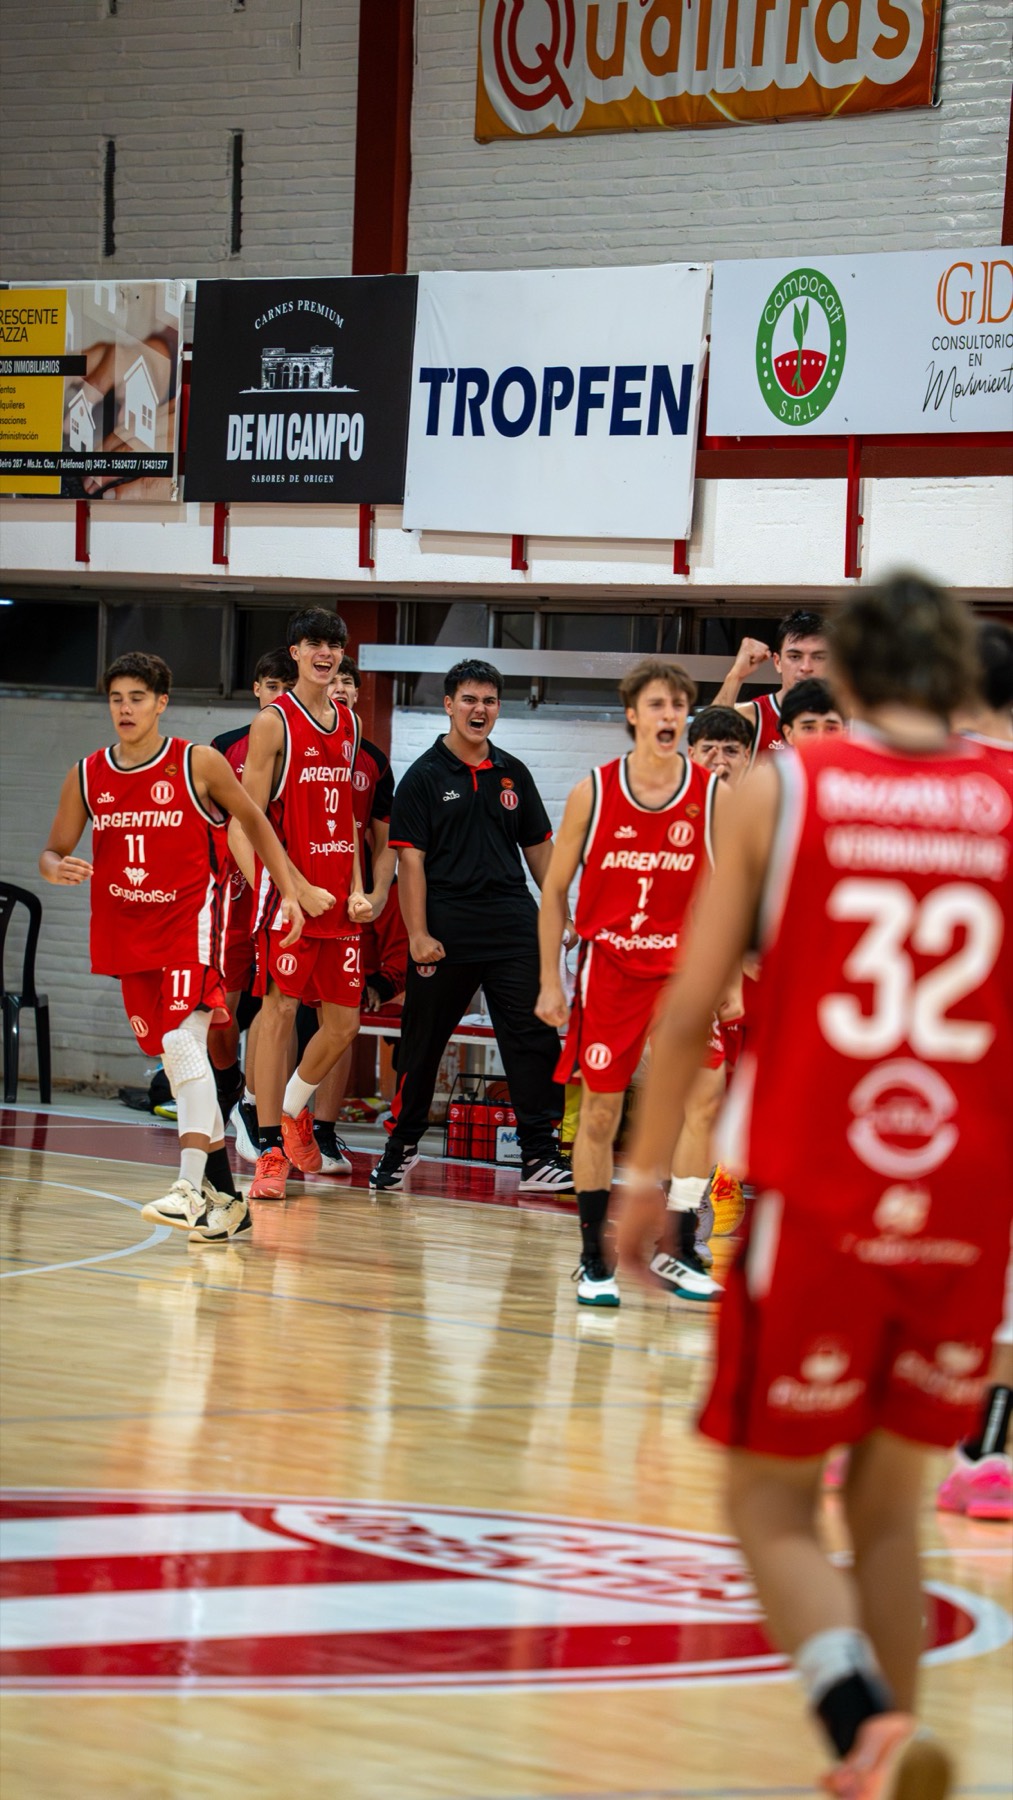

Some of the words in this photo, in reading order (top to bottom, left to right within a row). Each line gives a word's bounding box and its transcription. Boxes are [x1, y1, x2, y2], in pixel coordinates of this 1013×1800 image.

[254, 300, 294, 330] CARNES
[297, 299, 345, 329] PREMIUM
[932, 333, 1013, 351] CONSULTORIO
[13, 360, 60, 374] INMOBILIARIOS
[968, 353, 983, 367] EN
[419, 364, 694, 438] TROPFEN
[779, 400, 820, 422] S.R.L.
[226, 414, 255, 461] DE
[255, 413, 285, 461] MI
[286, 412, 365, 461] CAMPO
[12, 459, 23, 468] 287
[93, 459, 107, 469] 3472
[142, 460, 168, 470] 15431577
[251, 474, 285, 483] SABORES
[289, 474, 299, 483] DE
[303, 474, 335, 483] ORIGEN
[92, 810, 183, 831] ARGENTINO
[124, 834, 146, 863] 11
[600, 850, 695, 872] ARGENTINO
[817, 877, 1005, 1063] 32
[170, 969, 192, 998] 11
